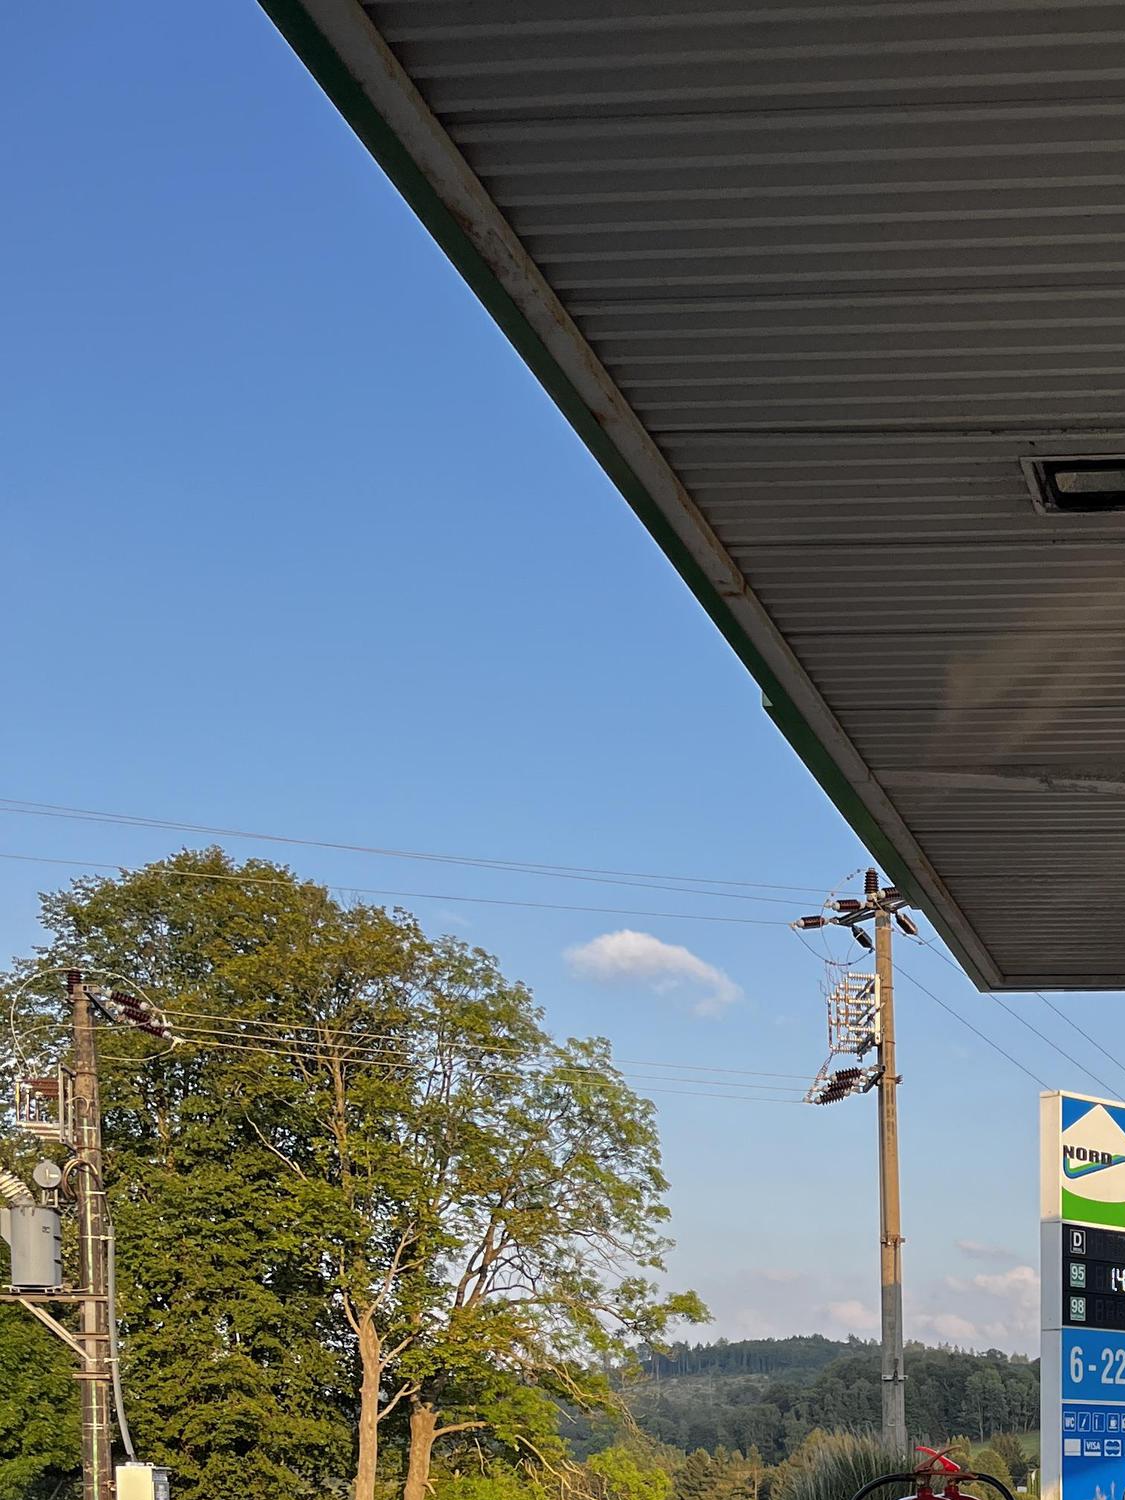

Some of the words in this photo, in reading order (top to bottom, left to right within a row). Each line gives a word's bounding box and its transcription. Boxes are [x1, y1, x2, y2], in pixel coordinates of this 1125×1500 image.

[1063, 1145, 1112, 1165] NORD
[1073, 1232, 1082, 1247] D
[1071, 1266, 1084, 1280] 95
[1071, 1299, 1084, 1314] 98
[1086, 1441, 1101, 1450] VISA
